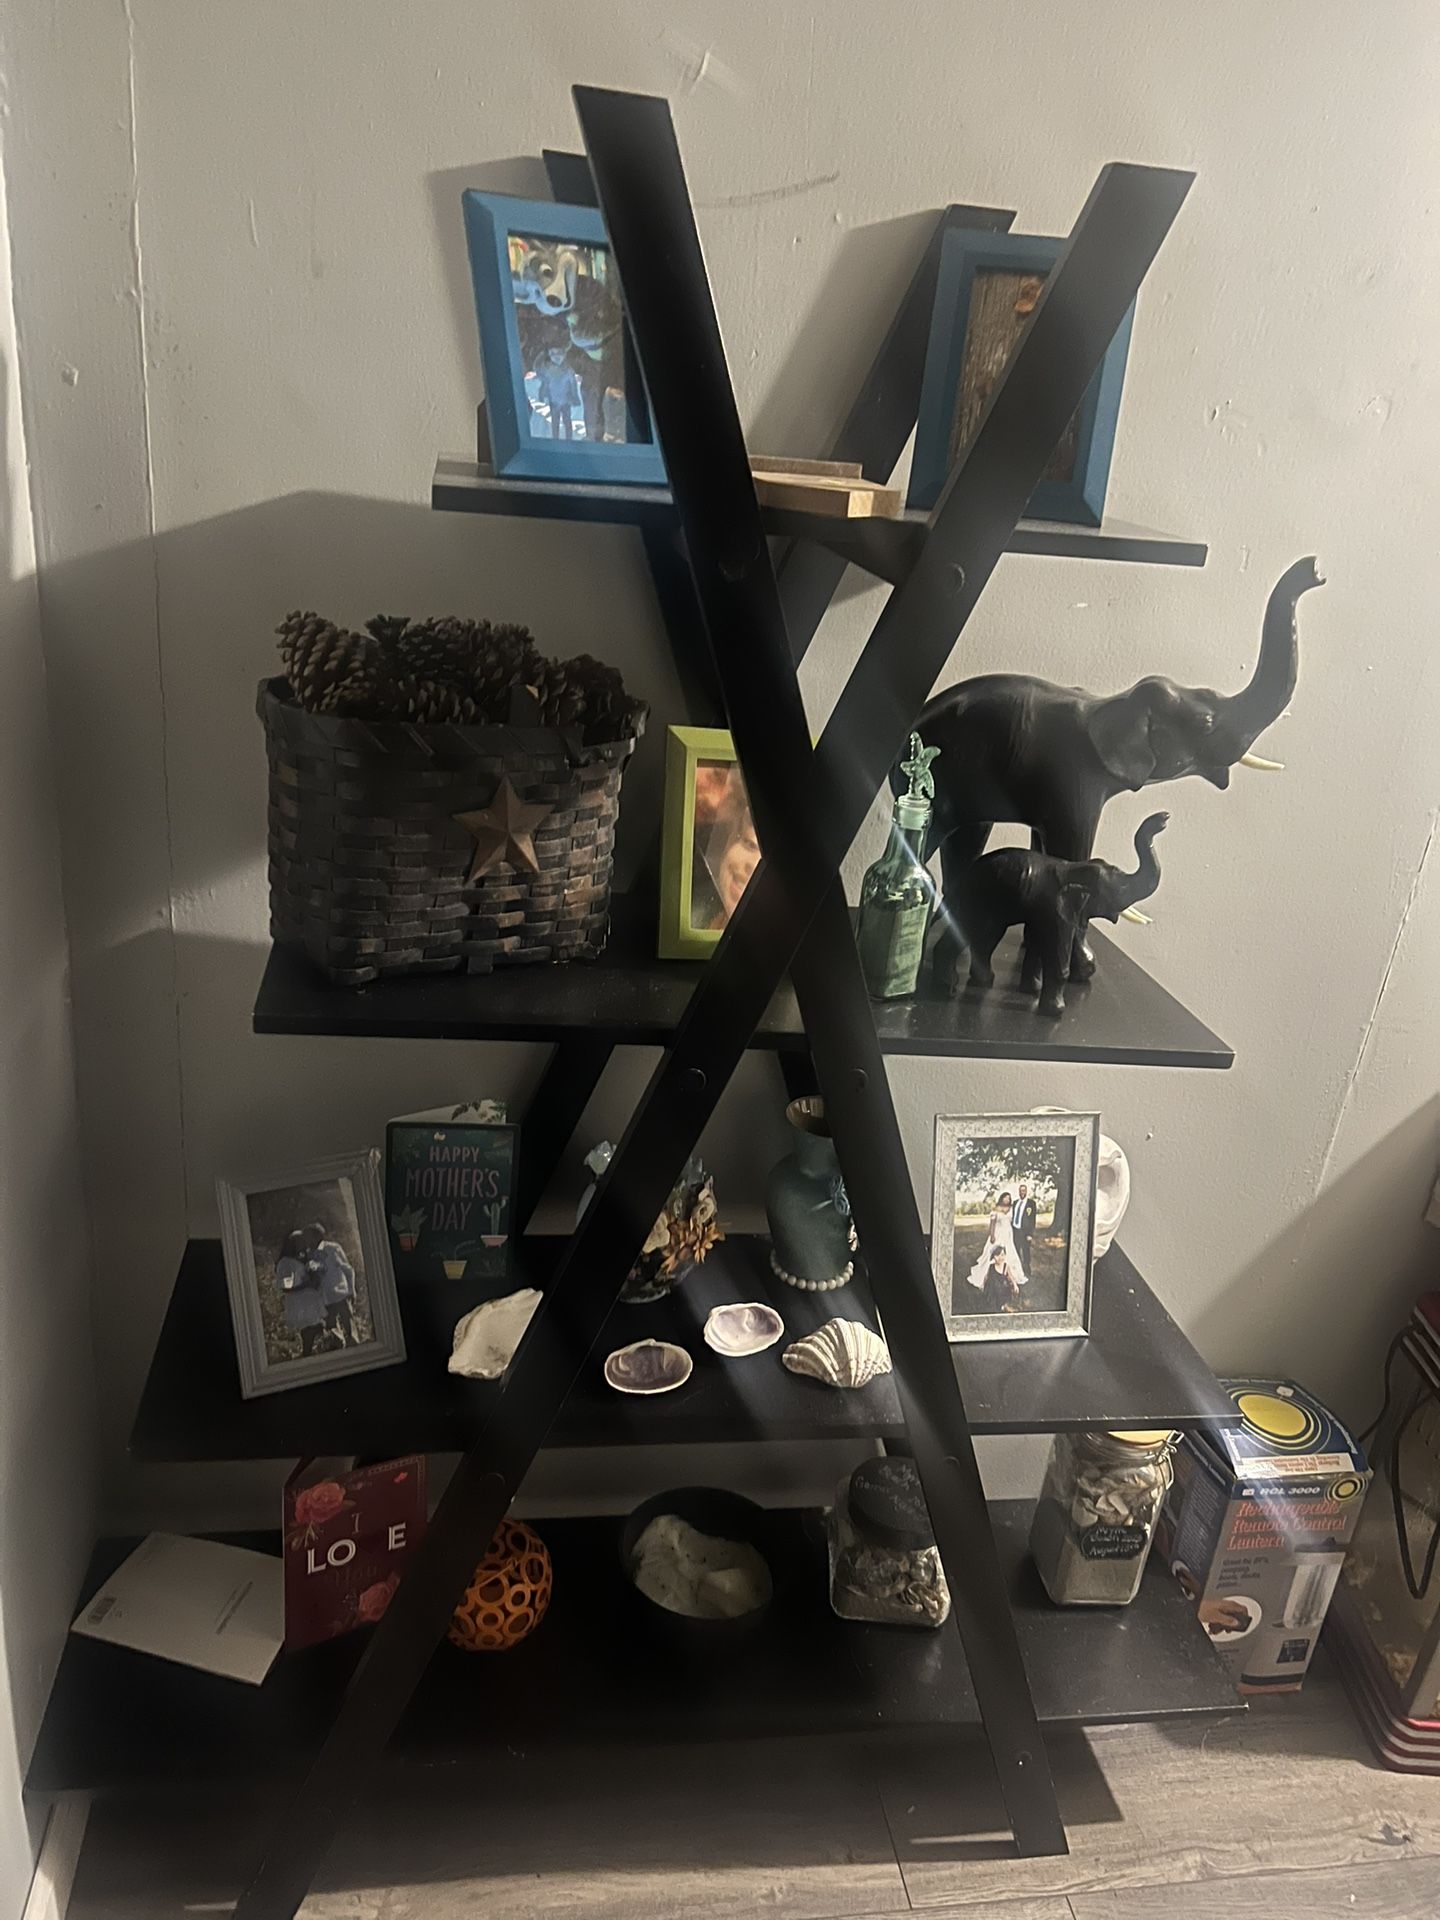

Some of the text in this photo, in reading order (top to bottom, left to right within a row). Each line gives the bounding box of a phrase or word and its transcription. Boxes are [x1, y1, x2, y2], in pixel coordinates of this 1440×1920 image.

[428, 1145, 480, 1163] HAPPY
[404, 1167, 500, 1199] MOTHER'S
[431, 1201, 473, 1231] DAY
[1288, 1486, 1320, 1495] 3000
[1236, 1499, 1341, 1519] Rechargeable
[1231, 1515, 1348, 1534] Remote Control
[1226, 1534, 1286, 1551] Lantern
